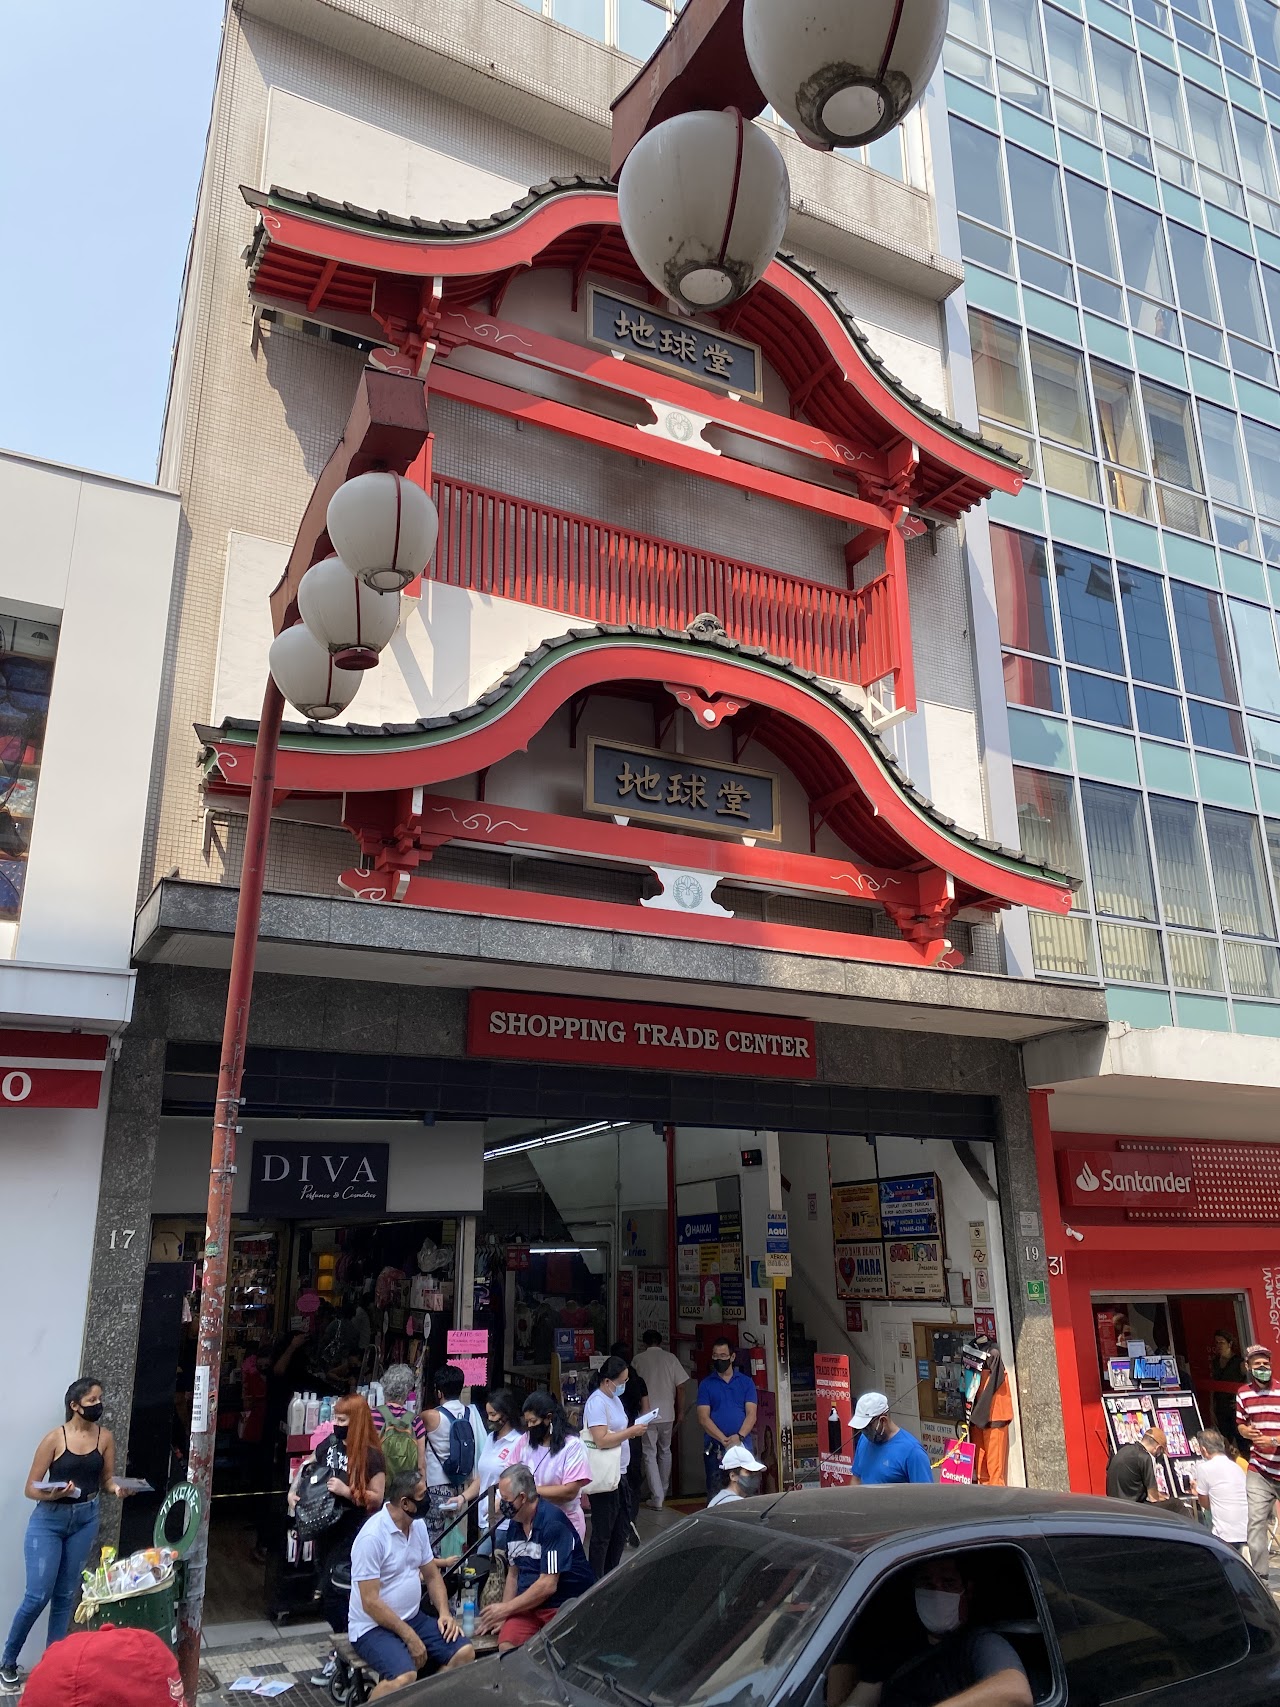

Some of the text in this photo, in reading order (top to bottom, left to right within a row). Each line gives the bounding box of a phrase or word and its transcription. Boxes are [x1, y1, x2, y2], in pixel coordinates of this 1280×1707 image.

[614, 309, 734, 379] 地球堂
[616, 761, 752, 820] 地球堂
[489, 1010, 810, 1058] SHOPPING TRADE CENTER
[261, 1154, 377, 1183] DIVA
[1101, 1169, 1191, 1193] Santander
[300, 1184, 330, 1200] Perfumes
[342, 1185, 377, 1200] Cosmetics
[692, 1223, 712, 1234] HAIKAI
[768, 1228, 787, 1236] AQUI
[109, 1229, 136, 1250] 17
[1025, 1246, 1039, 1261] 19
[857, 1258, 882, 1275] MARA
[1048, 1256, 1064, 1275] 31
[682, 1306, 701, 1315] LOJAS
[941, 1468, 971, 1484] Consertos
